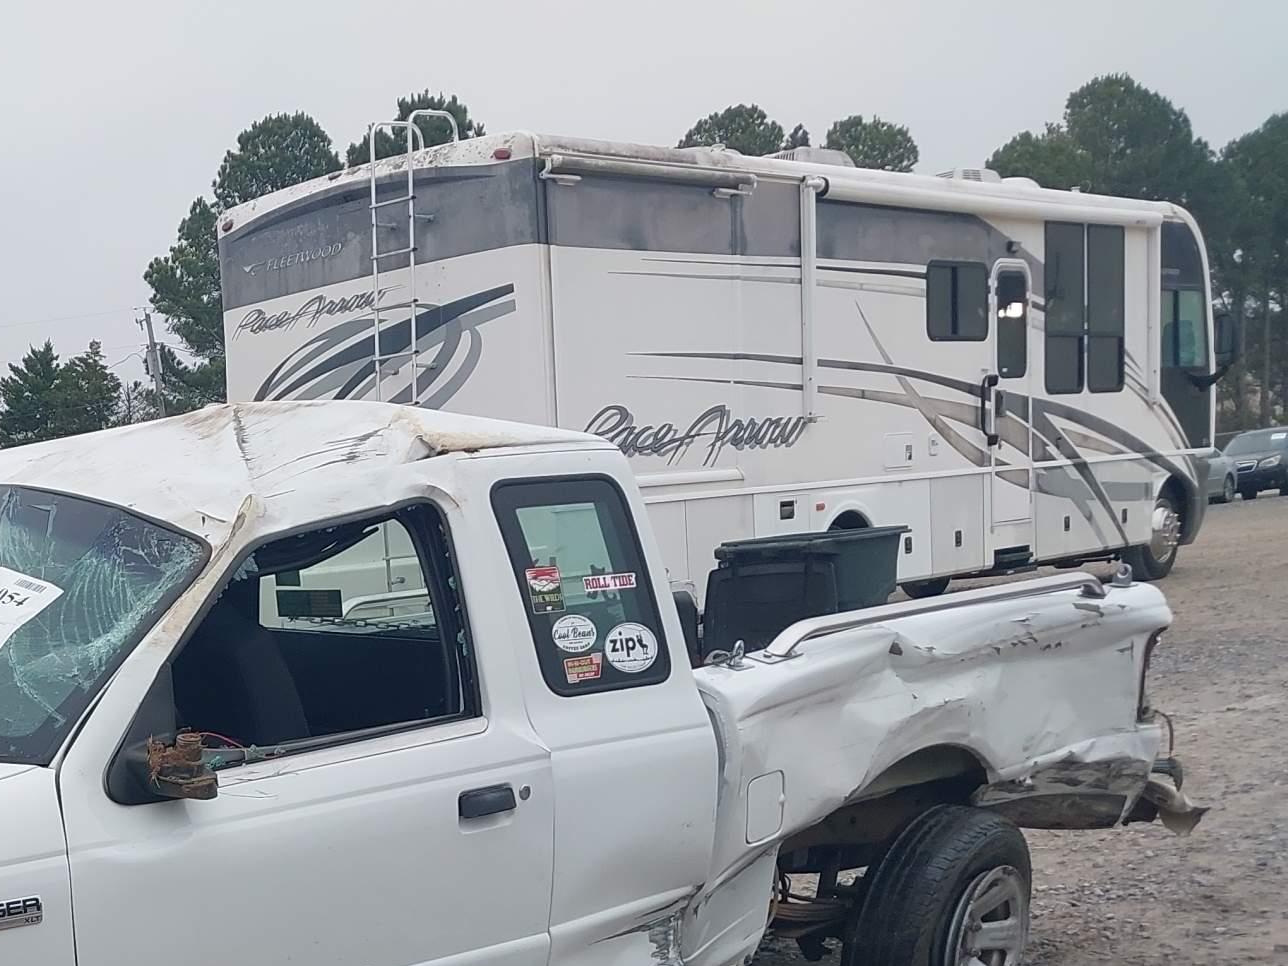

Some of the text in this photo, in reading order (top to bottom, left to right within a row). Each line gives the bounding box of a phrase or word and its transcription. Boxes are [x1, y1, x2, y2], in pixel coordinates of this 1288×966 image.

[266, 243, 342, 271] FLEETWOOD
[231, 284, 402, 341] Pace Arrow
[584, 404, 822, 468] Pace Arrow
[584, 574, 634, 590] ROLL TIDE
[553, 629, 570, 641] Cool
[24, 915, 41, 924] XLT
